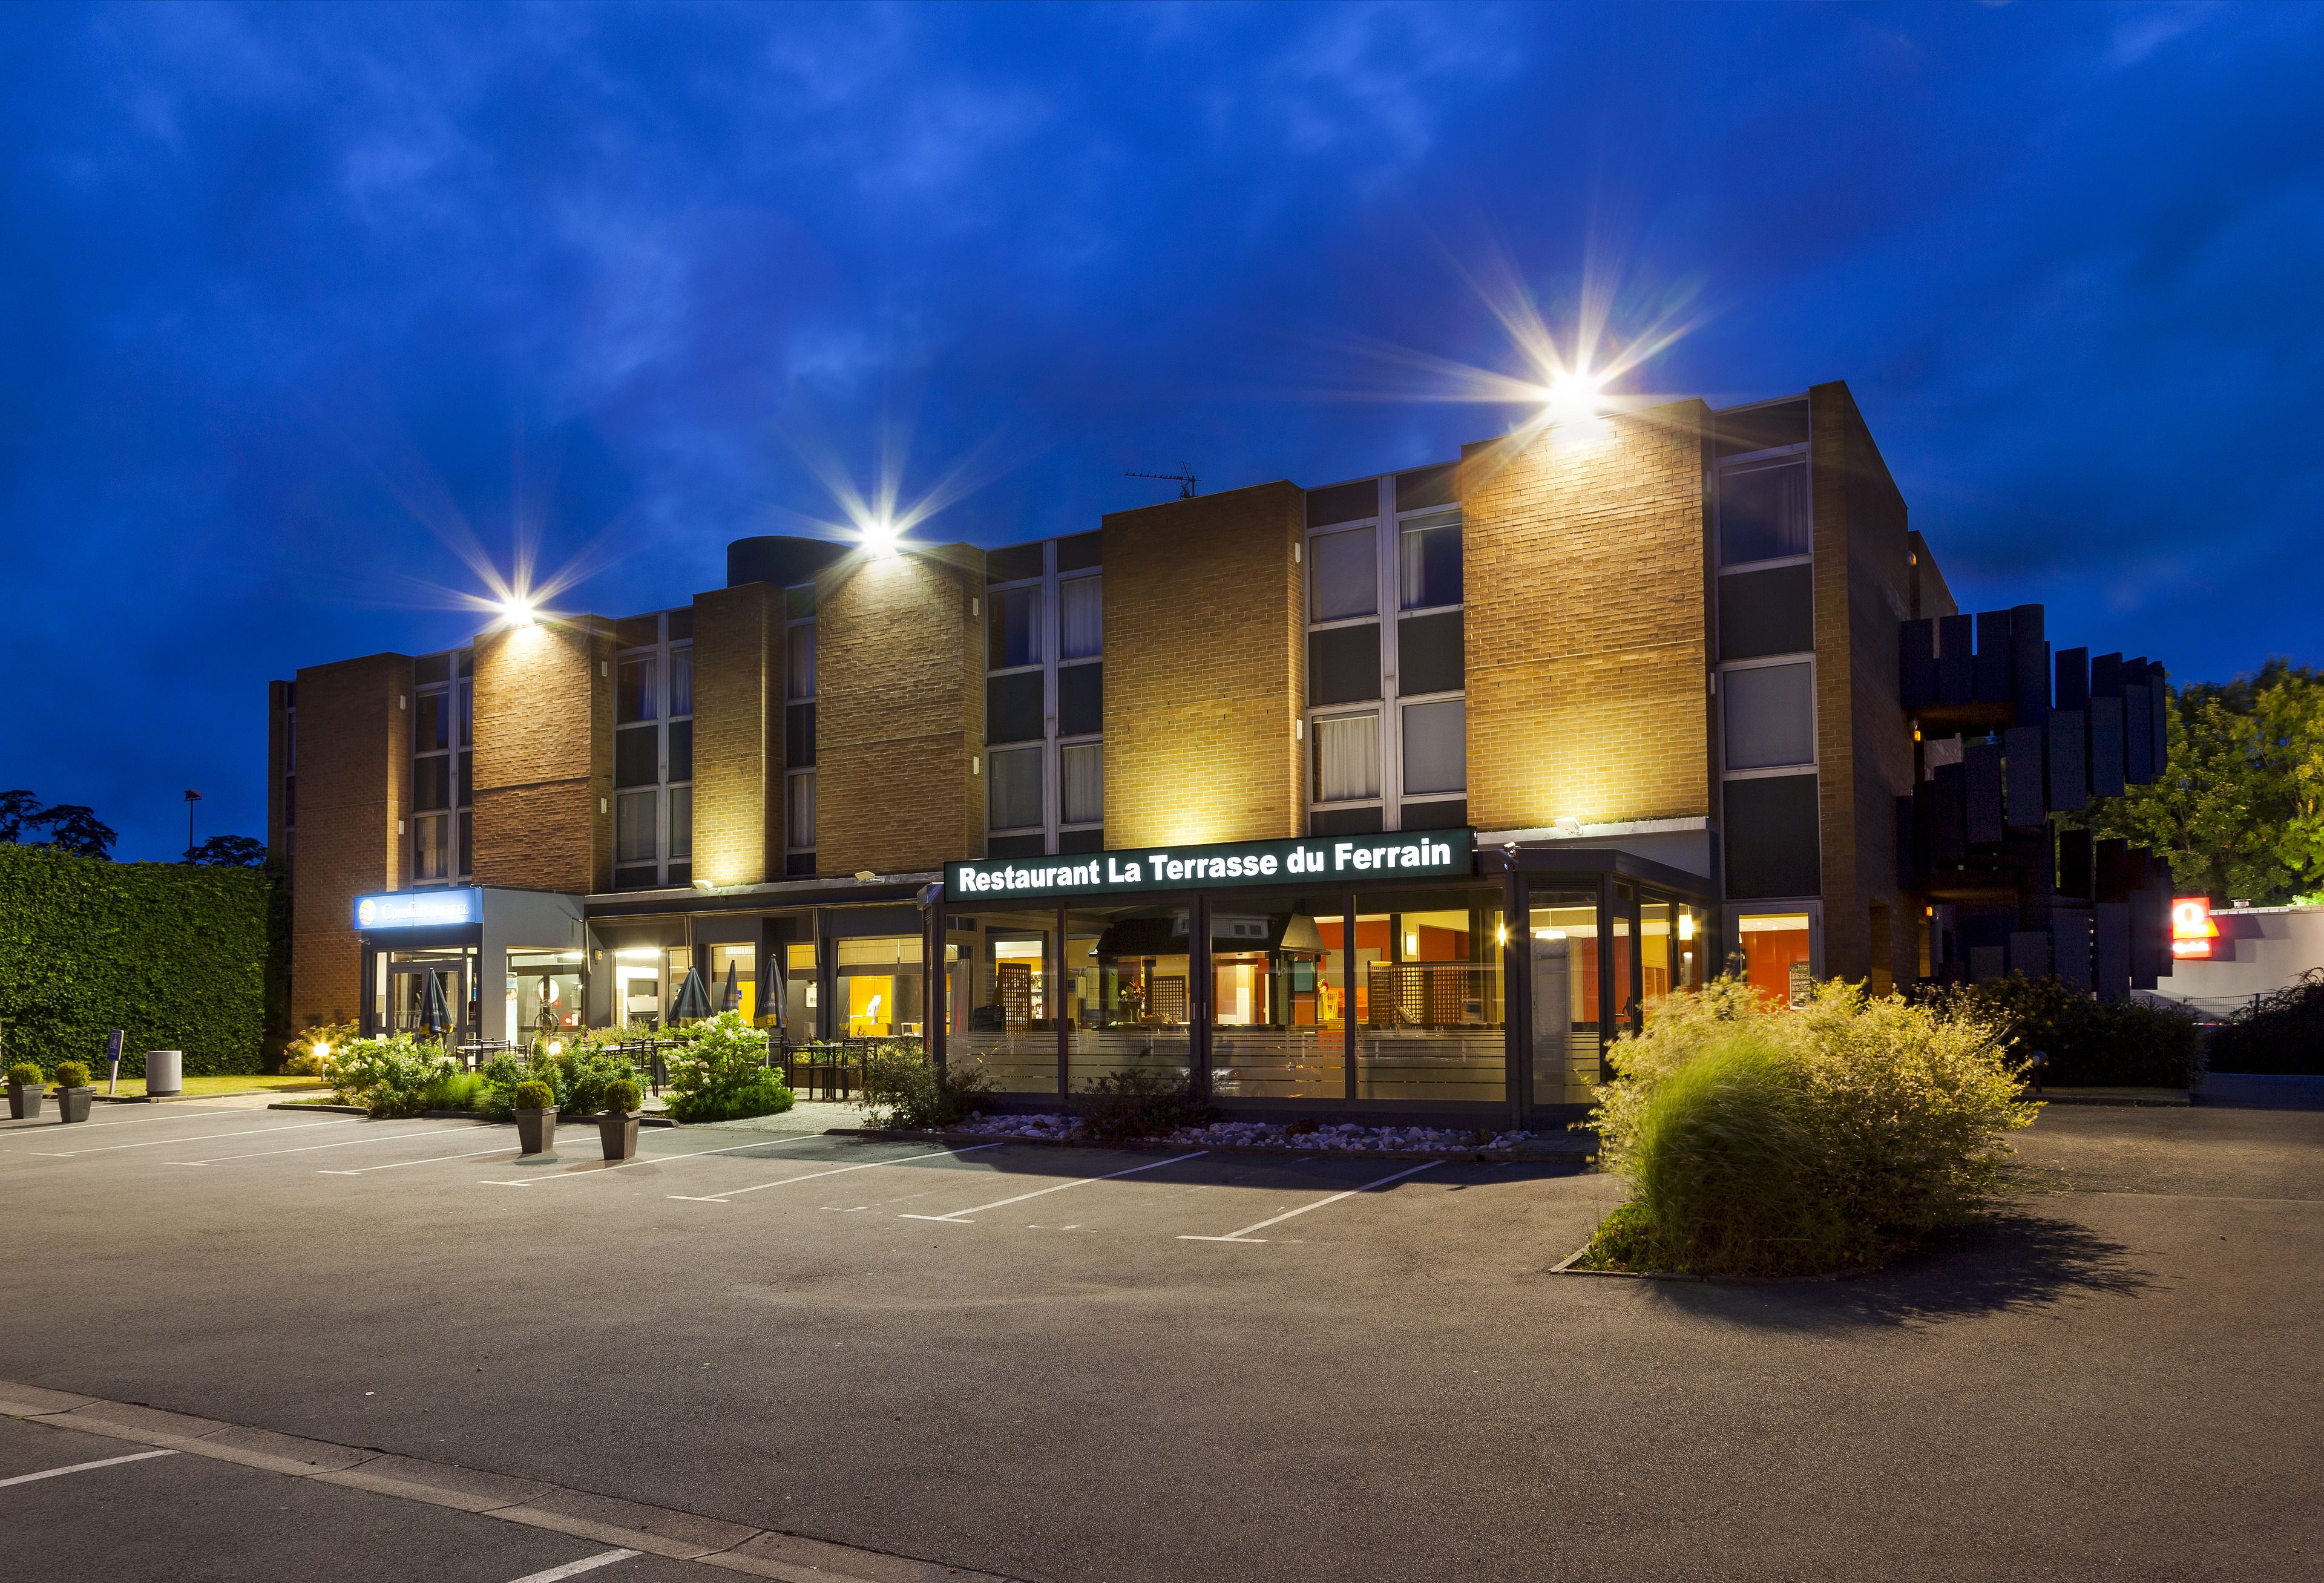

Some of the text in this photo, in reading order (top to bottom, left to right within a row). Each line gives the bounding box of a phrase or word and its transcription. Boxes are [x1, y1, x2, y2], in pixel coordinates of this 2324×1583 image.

[959, 837, 1451, 892] Restaurant La Terrasse du Ferrain
[382, 901, 430, 919] Comfort
